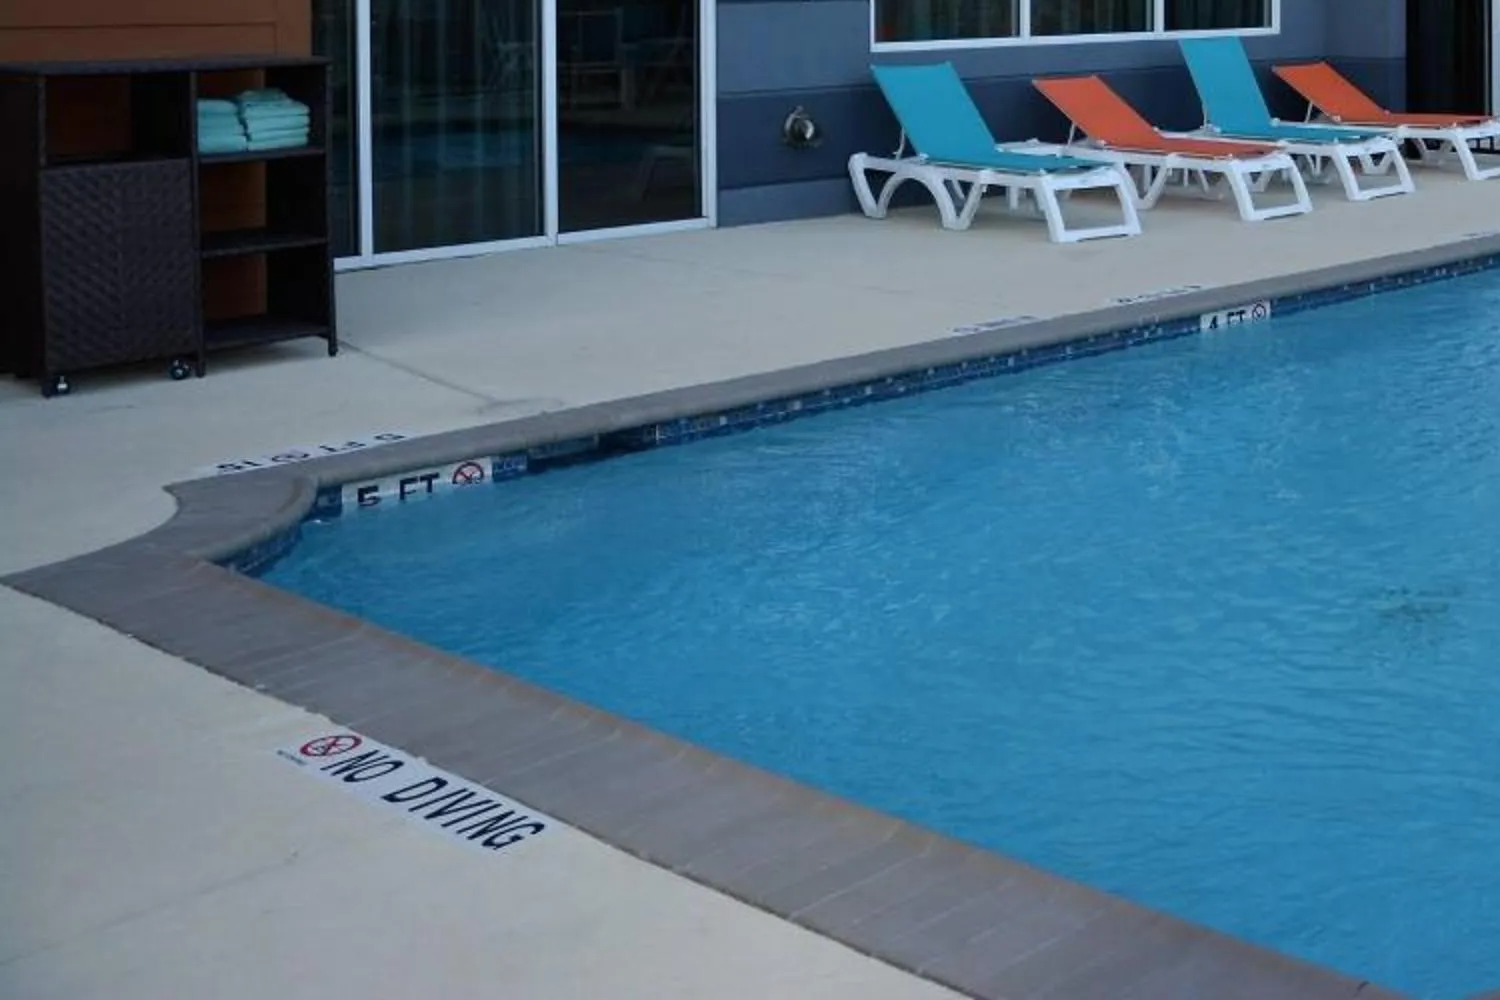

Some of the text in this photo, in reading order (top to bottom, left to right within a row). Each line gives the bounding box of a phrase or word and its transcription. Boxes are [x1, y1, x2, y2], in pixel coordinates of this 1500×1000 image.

[357, 472, 440, 507] 5 FT
[319, 749, 545, 851] NO DIVING
